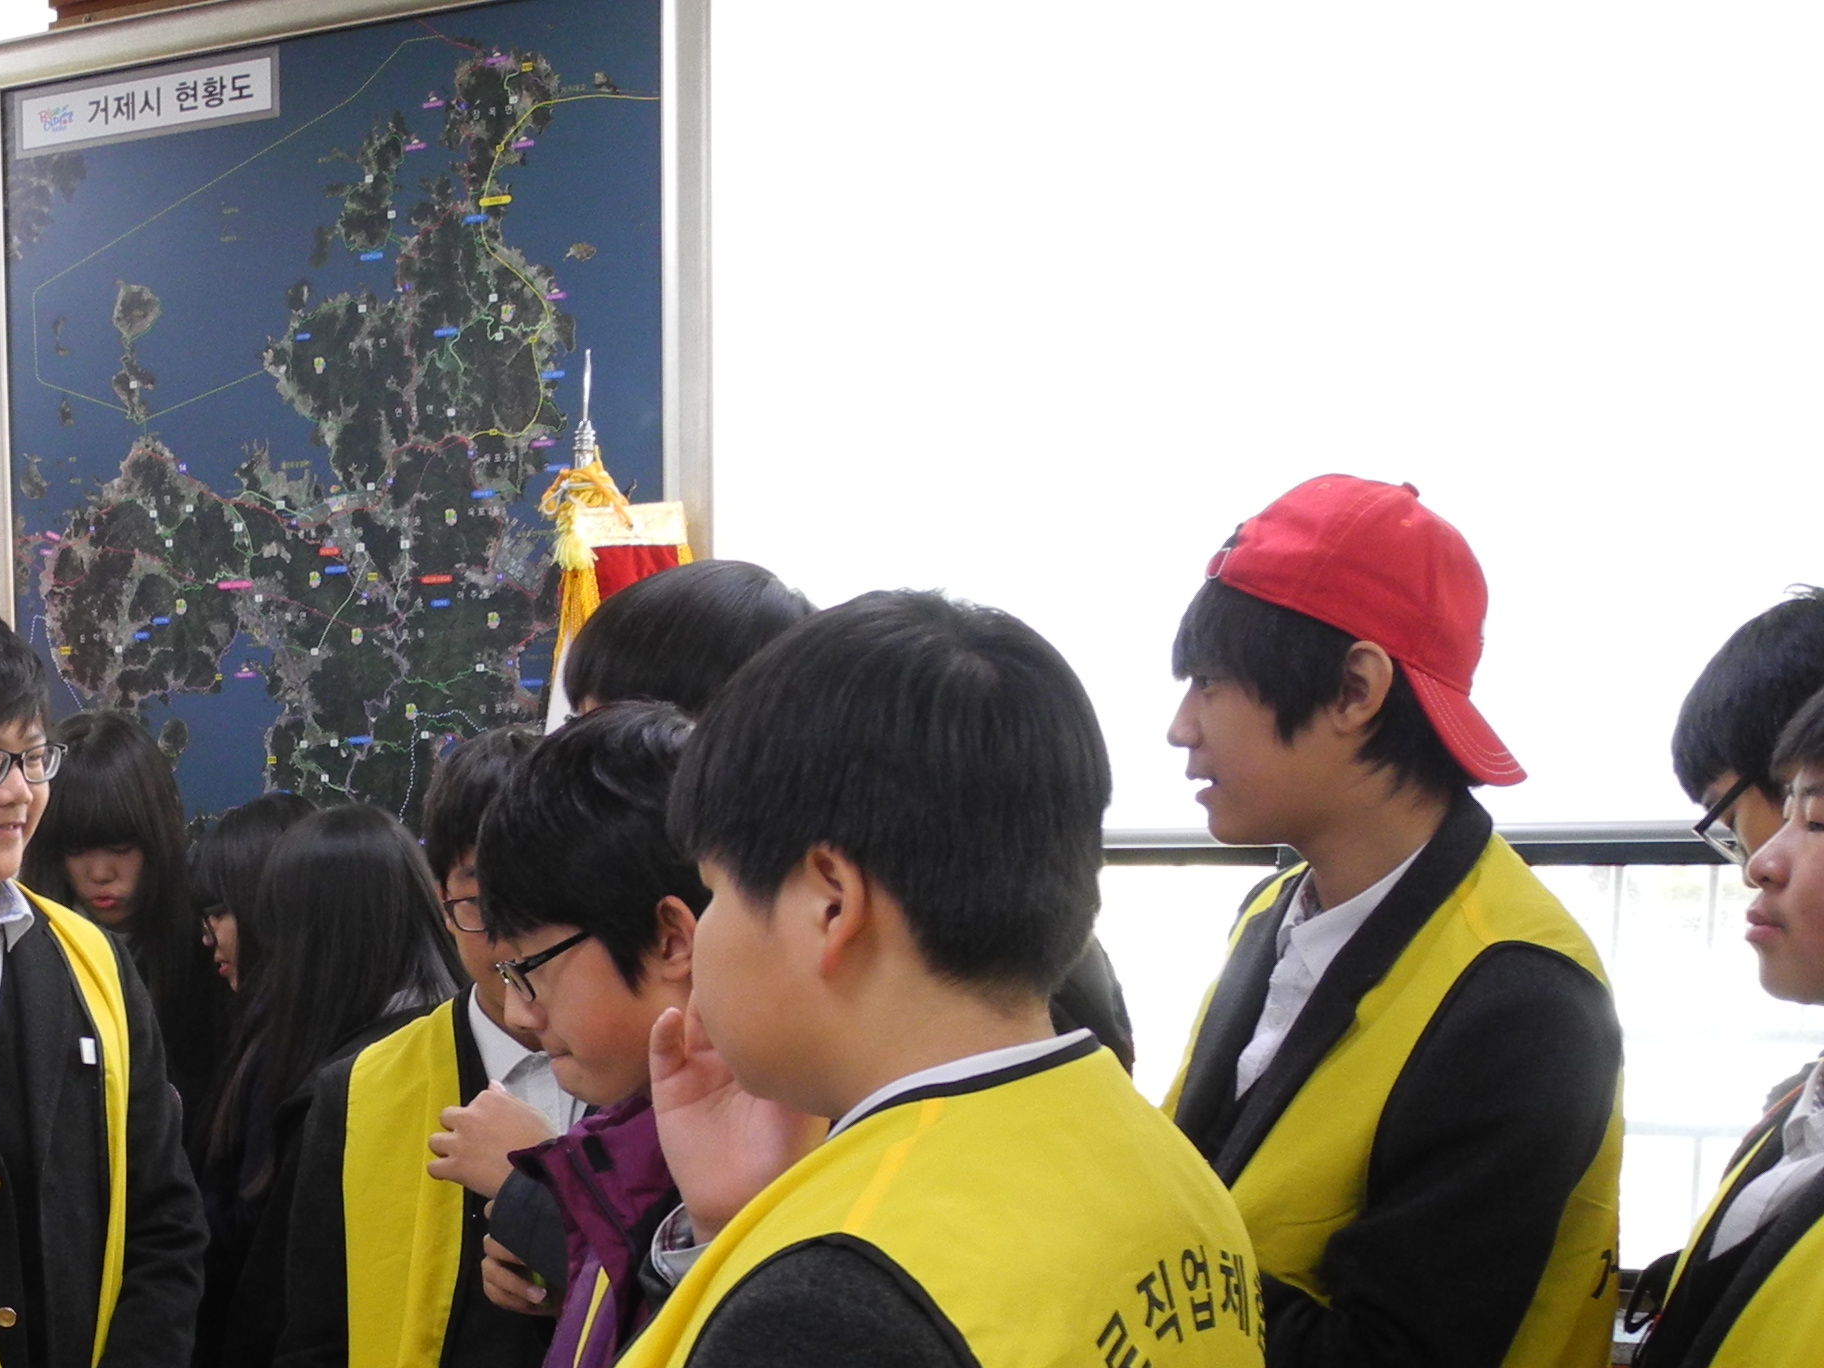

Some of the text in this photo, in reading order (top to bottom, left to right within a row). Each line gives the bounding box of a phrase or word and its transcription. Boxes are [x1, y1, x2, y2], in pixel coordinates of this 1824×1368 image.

[88, 73, 255, 126] 거제시 현황도
[179, 463, 188, 472] 14
